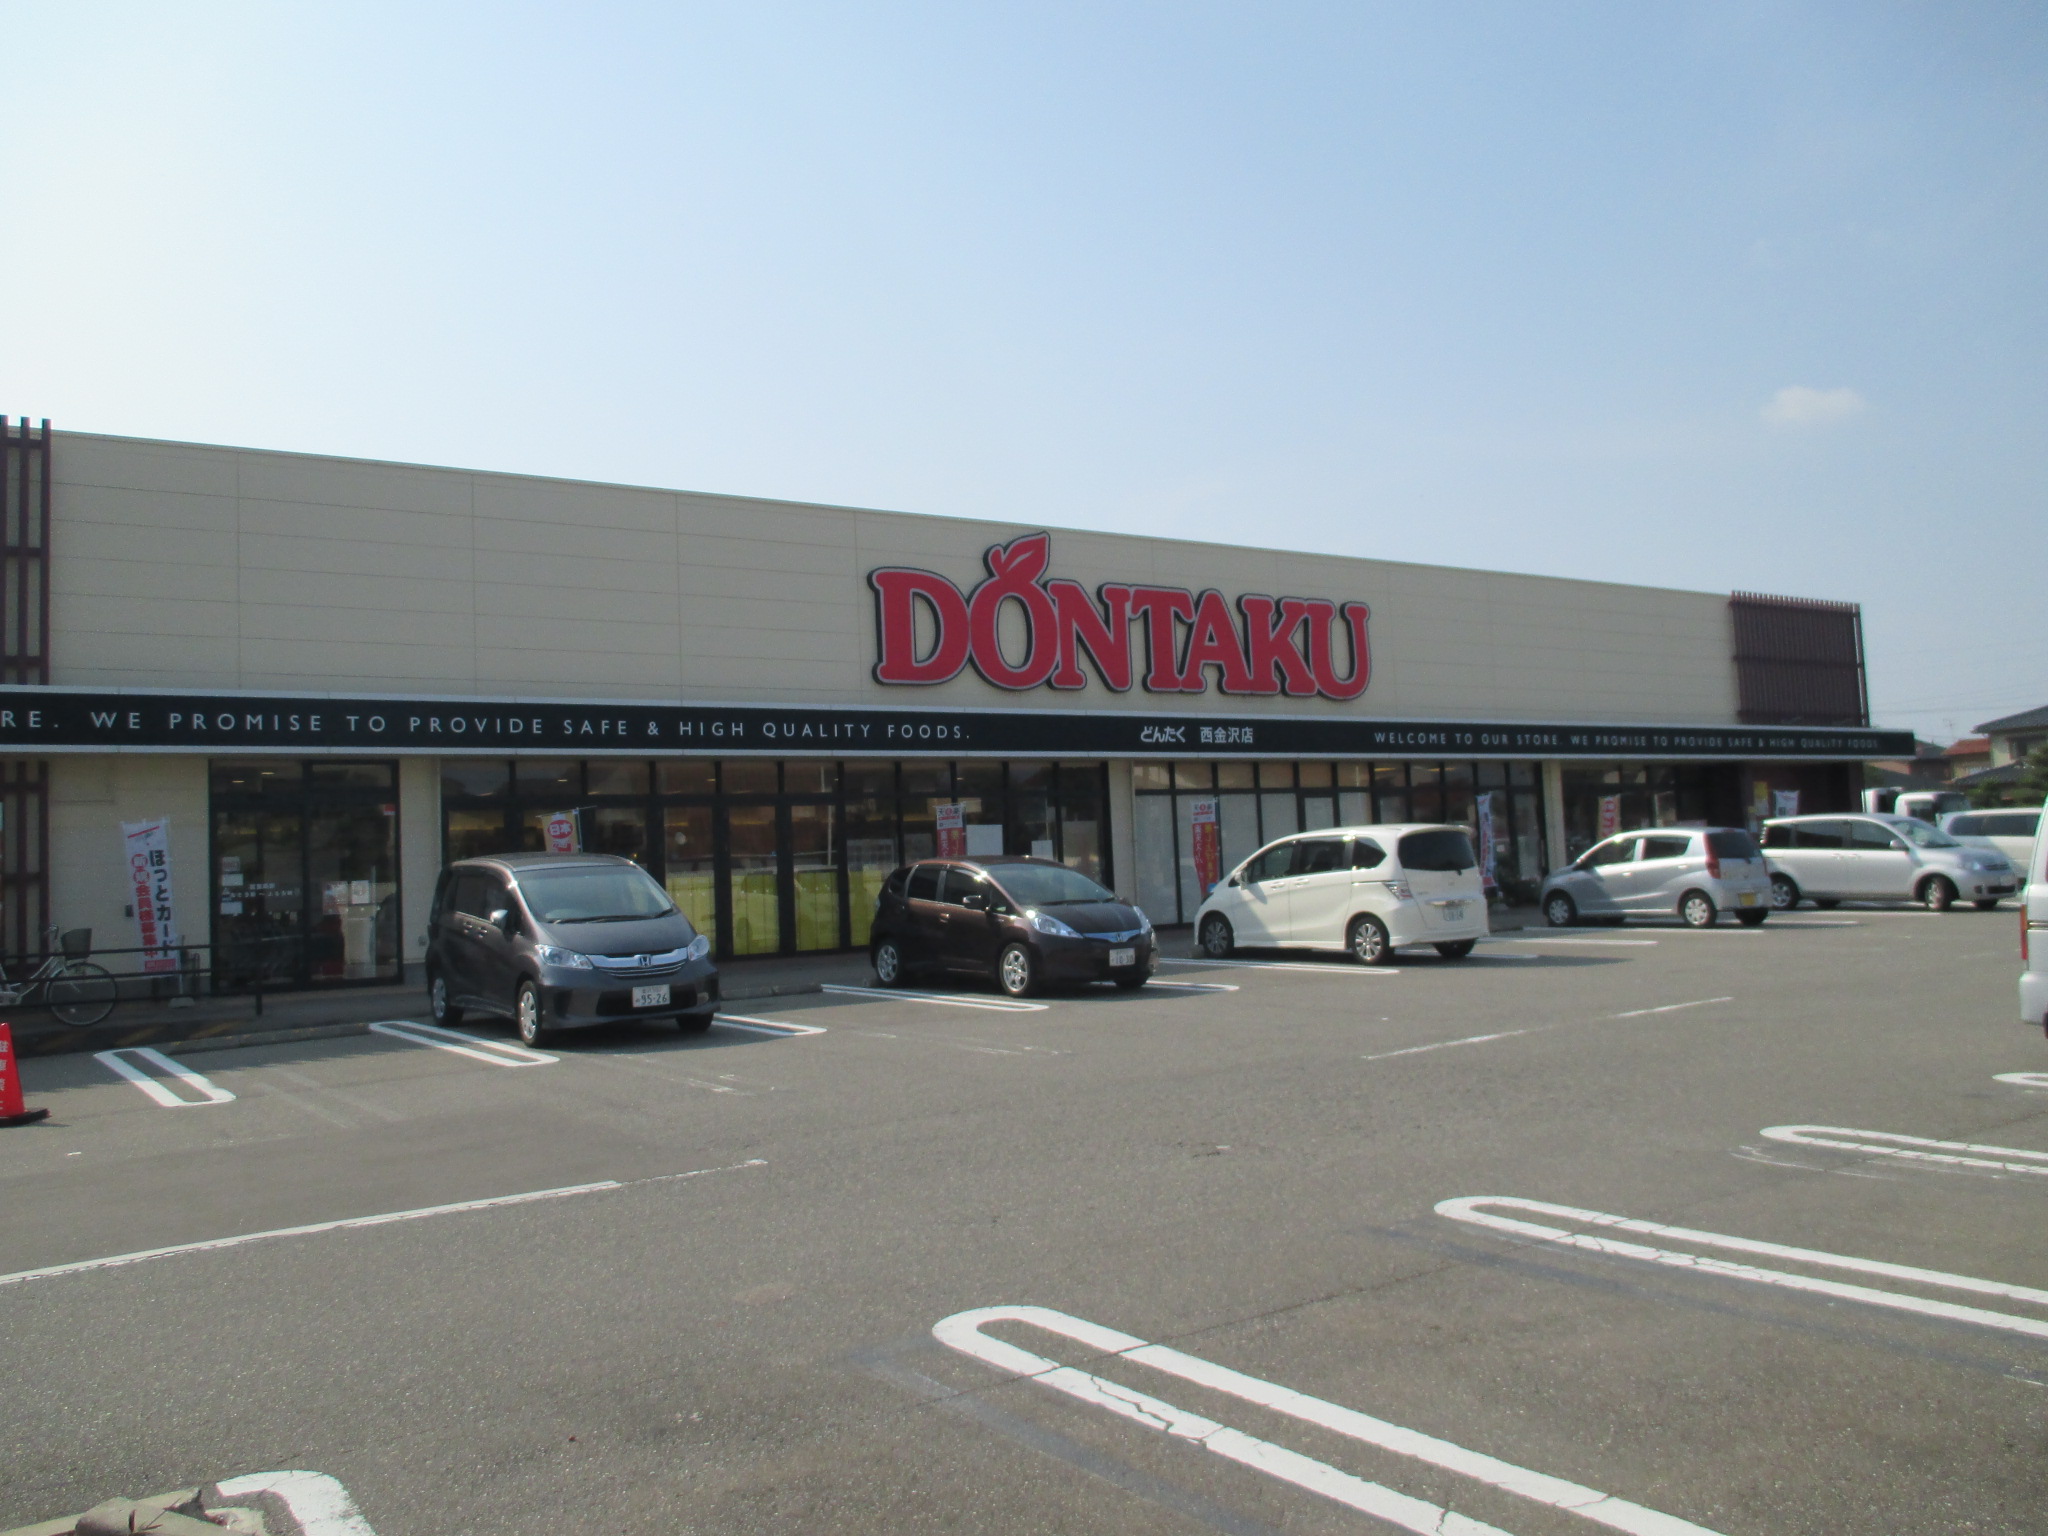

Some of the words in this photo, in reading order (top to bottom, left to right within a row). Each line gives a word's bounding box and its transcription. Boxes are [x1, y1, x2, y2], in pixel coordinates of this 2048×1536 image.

[867, 531, 1371, 700] DONTAKU
[91, 712, 141, 729] WE
[169, 713, 321, 731] PROMISE
[346, 716, 386, 732] TO
[409, 717, 543, 734] PROVIDE
[563, 720, 627, 735] SAFE
[647, 722, 659, 736] &
[679, 722, 744, 737] HIGH
[762, 722, 871, 738] QUALITY
[887, 725, 970, 739] FOODS.
[1140, 726, 1186, 743] どんたく
[1200, 727, 1254, 744] 西金沢店
[1374, 733, 1447, 745] WELCOME
[1455, 733, 1473, 745] TO
[1481, 734, 1509, 745] OUR
[1570, 735, 1588, 747] WE
[1595, 736, 1647, 747] PROMISE
[1653, 737, 1668, 747] TO
[1674, 737, 1722, 748] PROVIDE
[1728, 738, 1752, 748] SAFE
[1769, 739, 1795, 748] HIGH
[148, 849, 174, 958] ほっとカード
